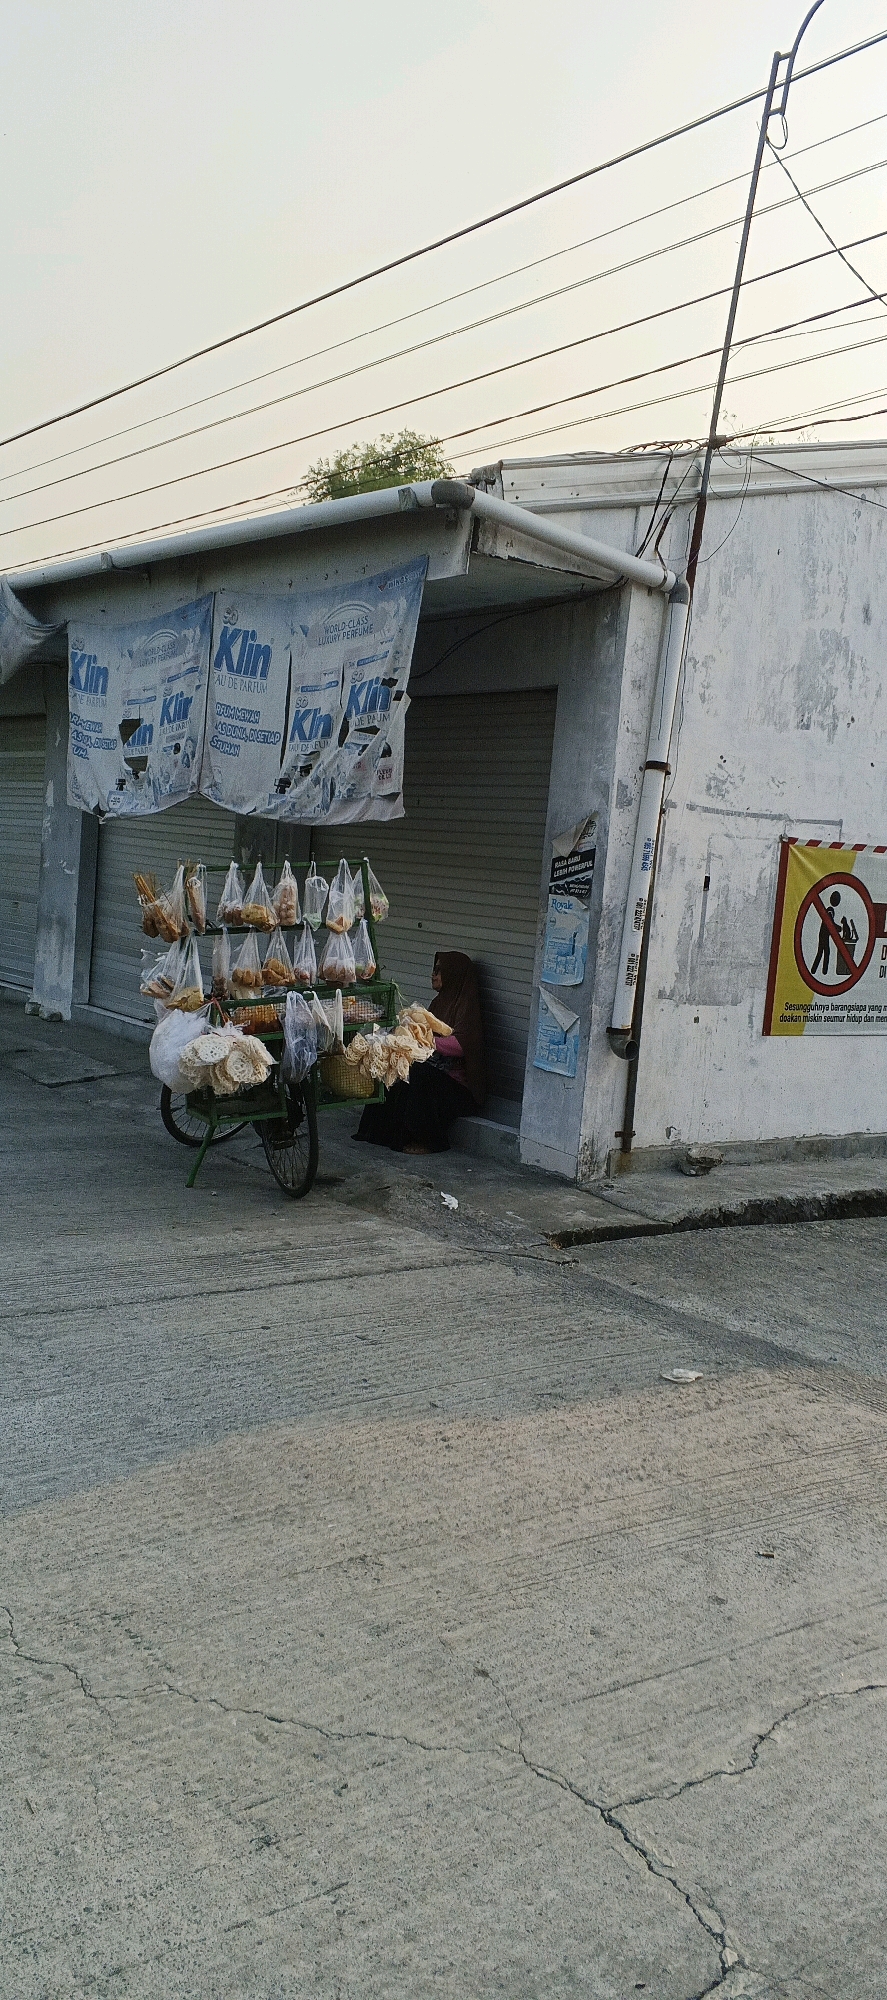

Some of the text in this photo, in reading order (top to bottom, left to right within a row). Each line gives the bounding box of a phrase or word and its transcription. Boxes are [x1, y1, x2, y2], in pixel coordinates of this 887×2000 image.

[324, 615, 370, 634] WORLD-CLASS
[342, 624, 375, 641] PERFUME
[213, 625, 273, 681] Klin
[69, 650, 110, 698] Klin
[239, 680, 268, 694] PARFUM
[346, 676, 393, 720] Klin
[160, 690, 193, 727] Klin
[257, 730, 282, 745] SETIAP
[554, 859, 568, 869] RASA
[568, 860, 594, 873] POWERFUL
[551, 898, 574, 911] Royale
[784, 1002, 829, 1014] Sesungguhnya
[831, 1003, 866, 1014] barangsiapa
[867, 1005, 882, 1014] yang
[780, 1013, 801, 1023] doakan
[802, 1013, 823, 1023] miskin
[824, 1015, 846, 1023] seumur
[847, 1013, 862, 1025] hidup
[864, 1014, 874, 1023] dan
